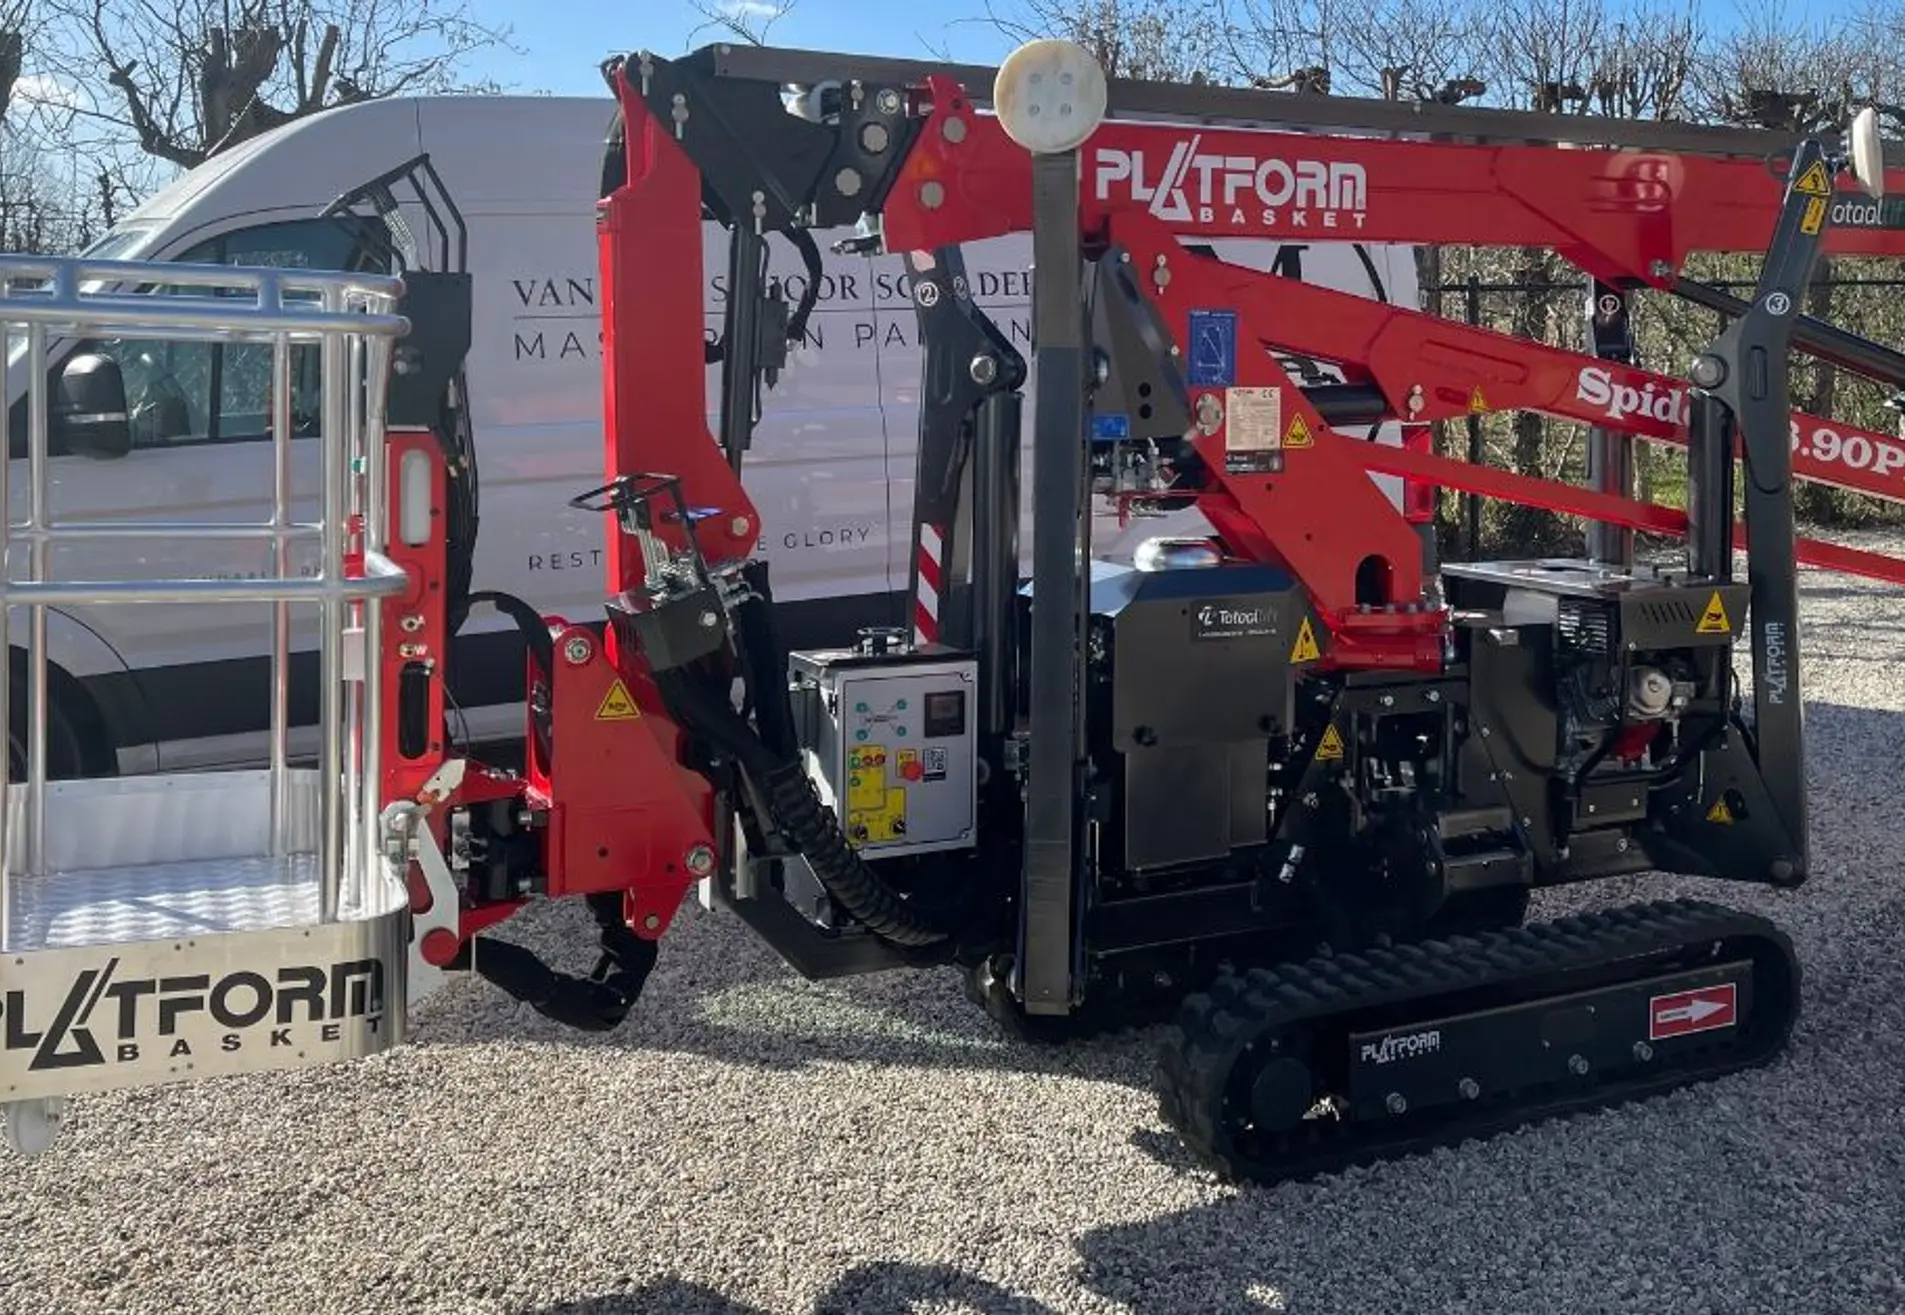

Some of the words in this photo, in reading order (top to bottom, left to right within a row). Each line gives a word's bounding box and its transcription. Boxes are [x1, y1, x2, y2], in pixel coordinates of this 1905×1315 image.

[1096, 134, 1367, 221] PLATFORM
[1199, 206, 1366, 228] BASKET
[513, 278, 594, 306] VAN
[1576, 367, 1690, 426] Spid
[783, 527, 871, 549] GLORY
[0, 958, 384, 1071] LATFORM
[116, 1015, 383, 1063] BASKET
[1361, 1030, 1440, 1064] PLATFORM
